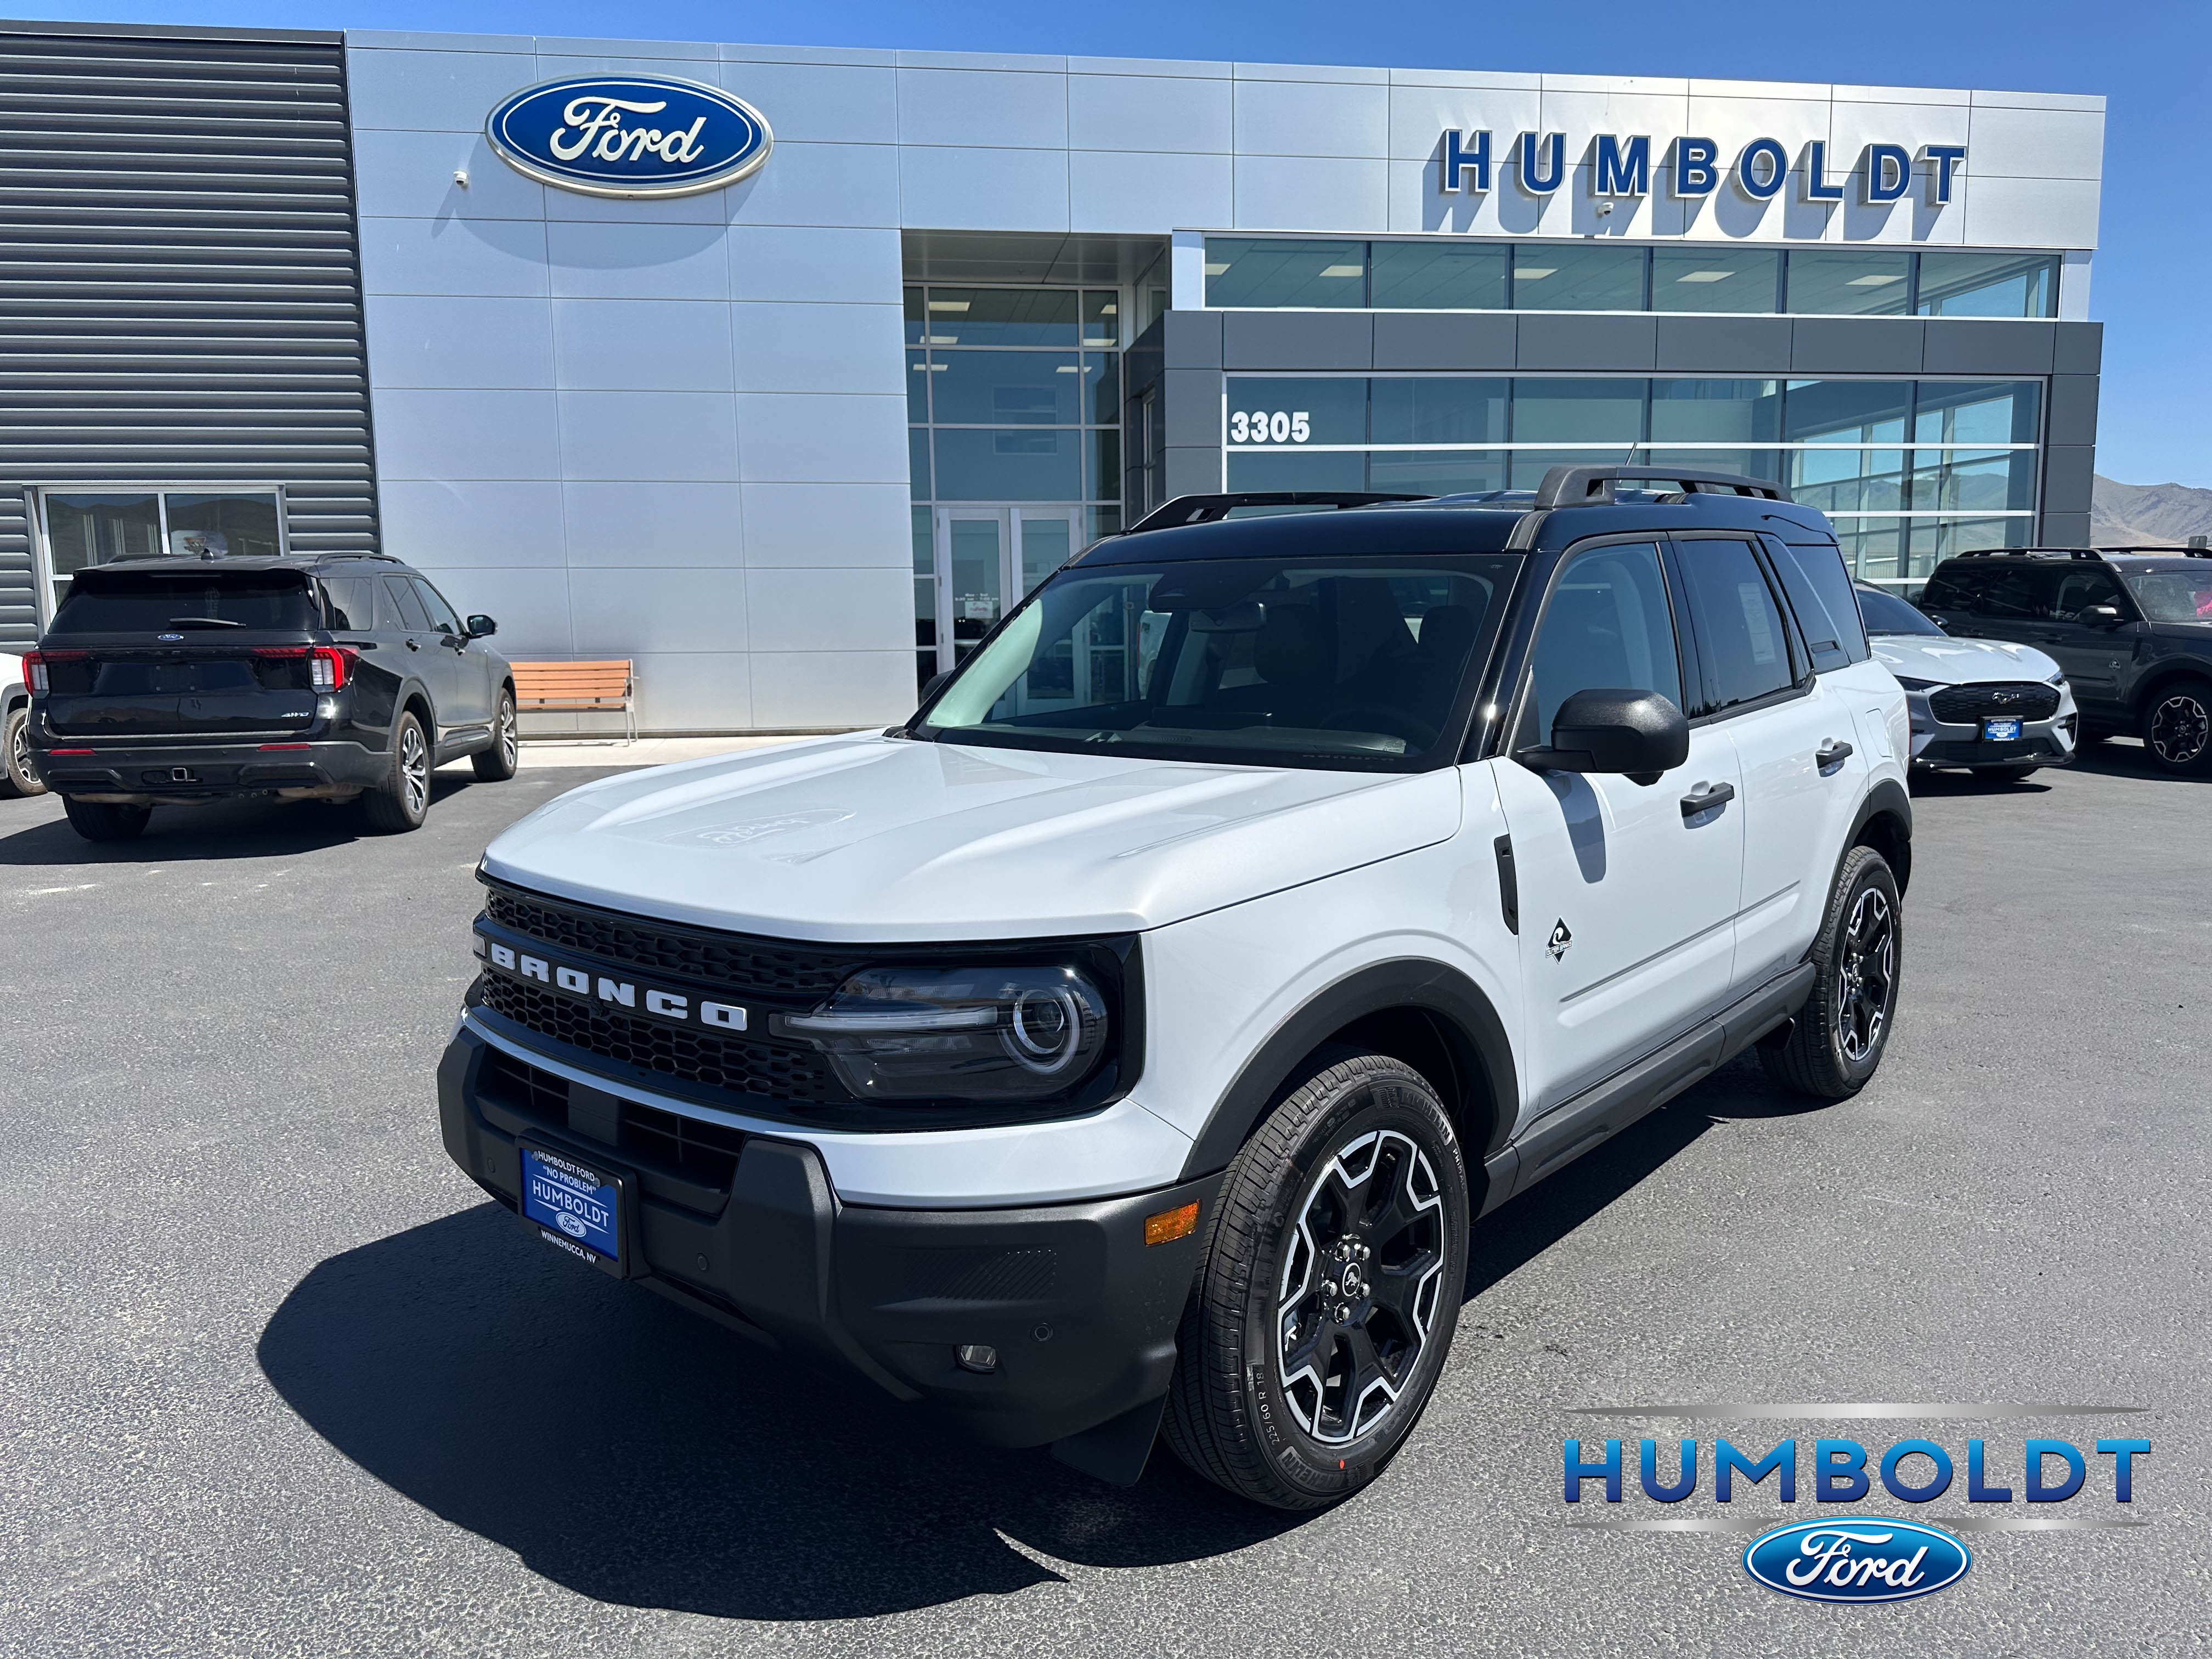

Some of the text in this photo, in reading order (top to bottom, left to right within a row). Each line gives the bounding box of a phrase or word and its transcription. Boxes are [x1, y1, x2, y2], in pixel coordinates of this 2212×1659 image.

[550, 96, 707, 163] Ford
[1444, 128, 1967, 205] HUMBOLDT
[1231, 410, 1310, 443] 3305
[490, 942, 748, 1031] BRONCO
[538, 1150, 595, 1181] HUMBOLDT FORD
[533, 1180, 609, 1227] HUMBOLDT
[563, 1216, 580, 1233] Ford
[541, 1229, 596, 1264] WINNEMUCCA, NV
[1256, 1372, 1265, 1386] 18
[1258, 1391, 1267, 1400] R
[1261, 1404, 1280, 1445] 225/60
